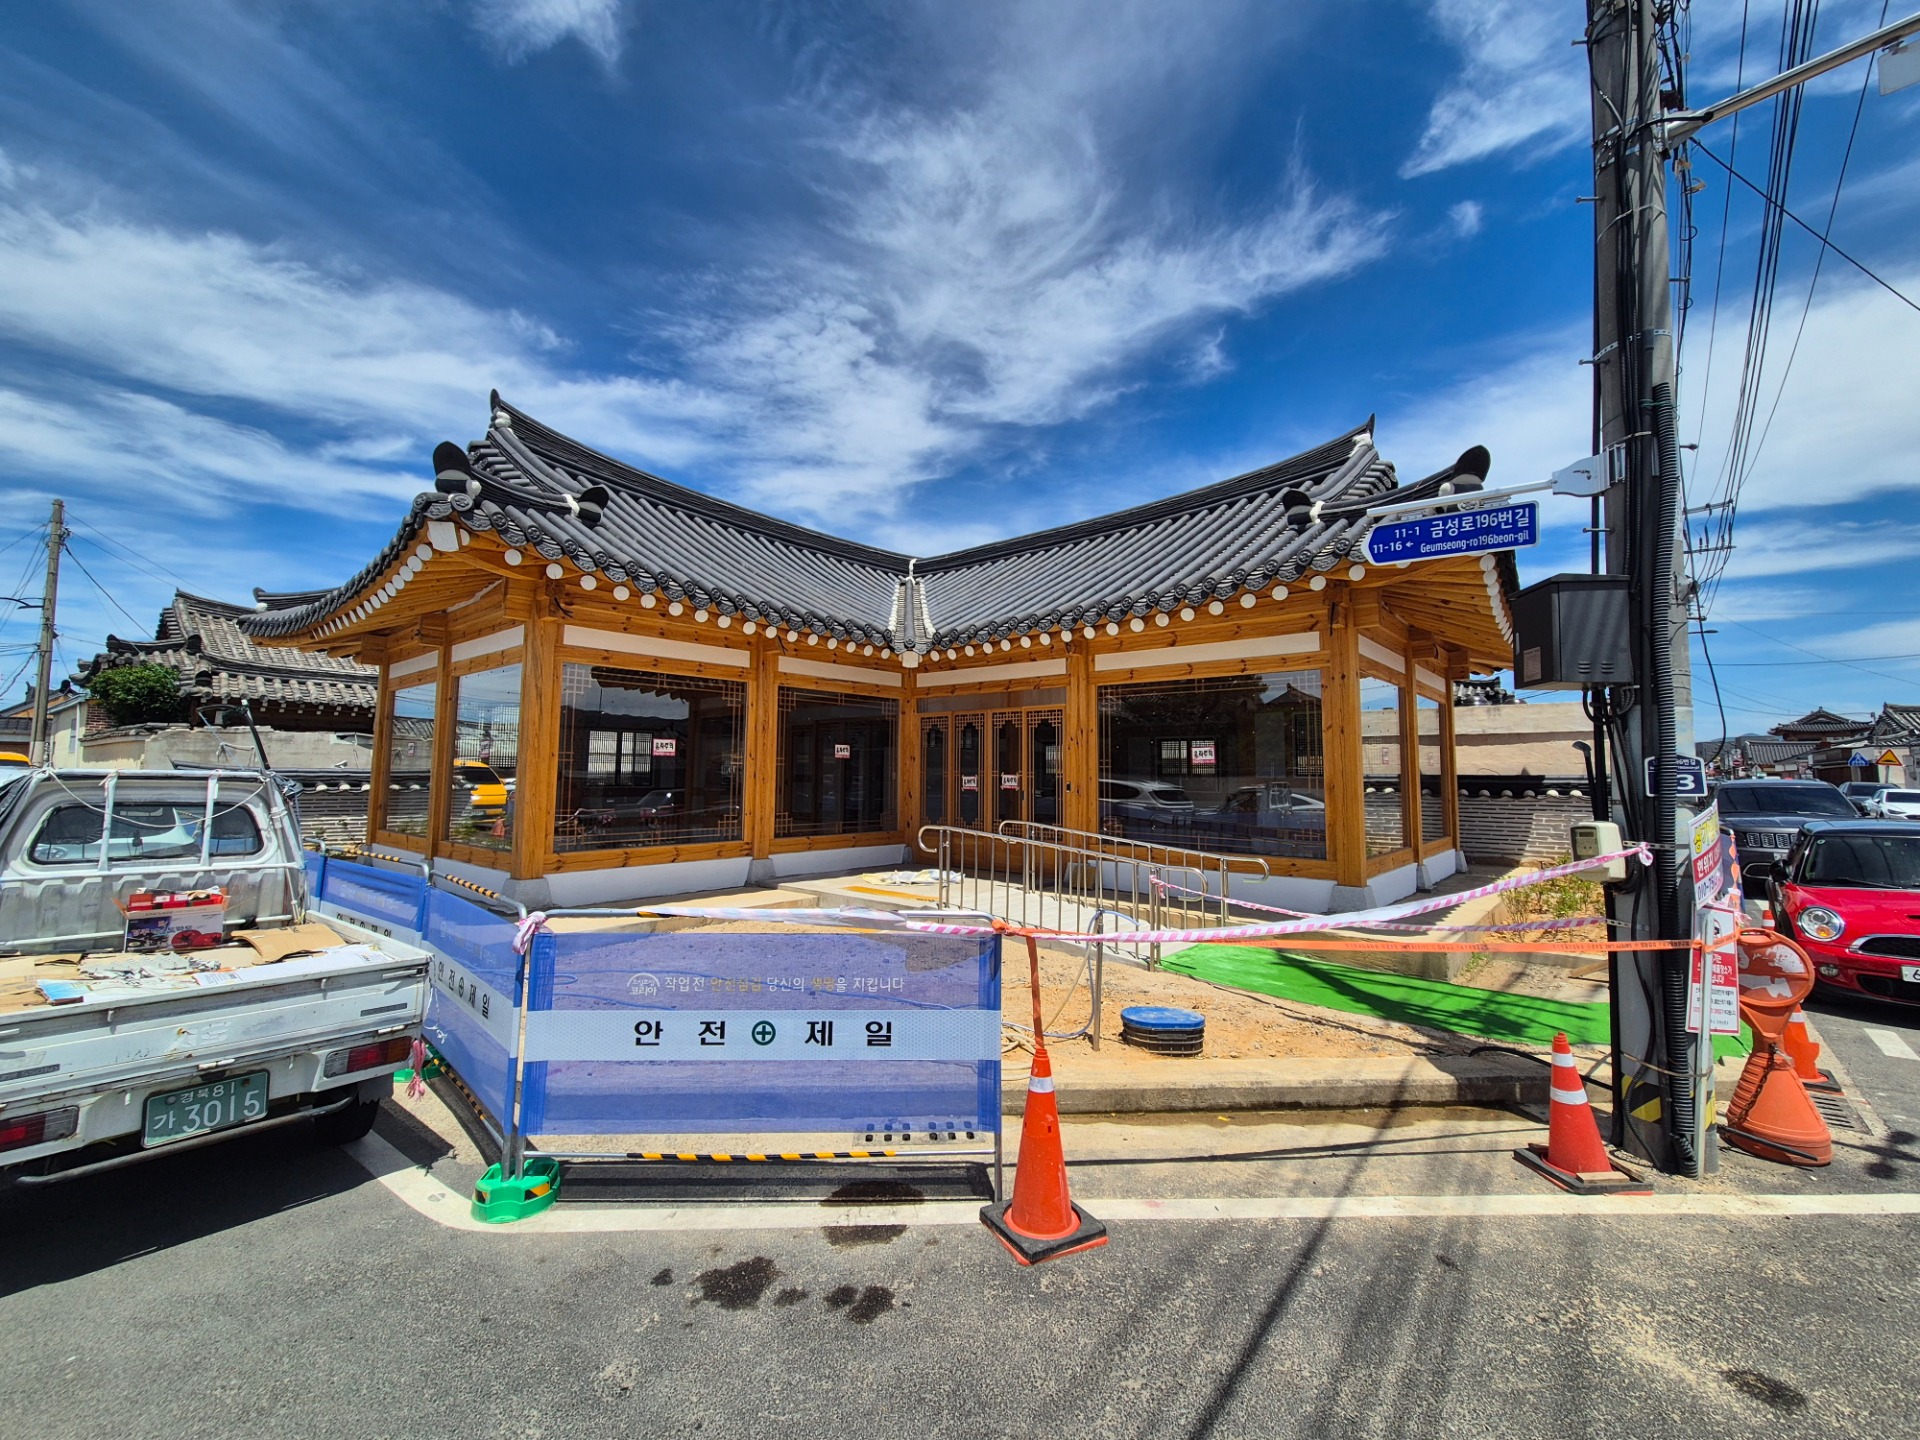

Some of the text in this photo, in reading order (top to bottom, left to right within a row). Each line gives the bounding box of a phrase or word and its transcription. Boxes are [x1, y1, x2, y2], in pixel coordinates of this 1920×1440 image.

[1394, 507, 1530, 539] 11-1 금성로196번길
[1372, 529, 1529, 554] 11-16 Geumseong-ro196beon-gil
[629, 986, 657, 996] 코리아
[766, 976, 806, 992] 당신의
[810, 976, 848, 993] 생명을
[852, 976, 906, 993] 지킵니다
